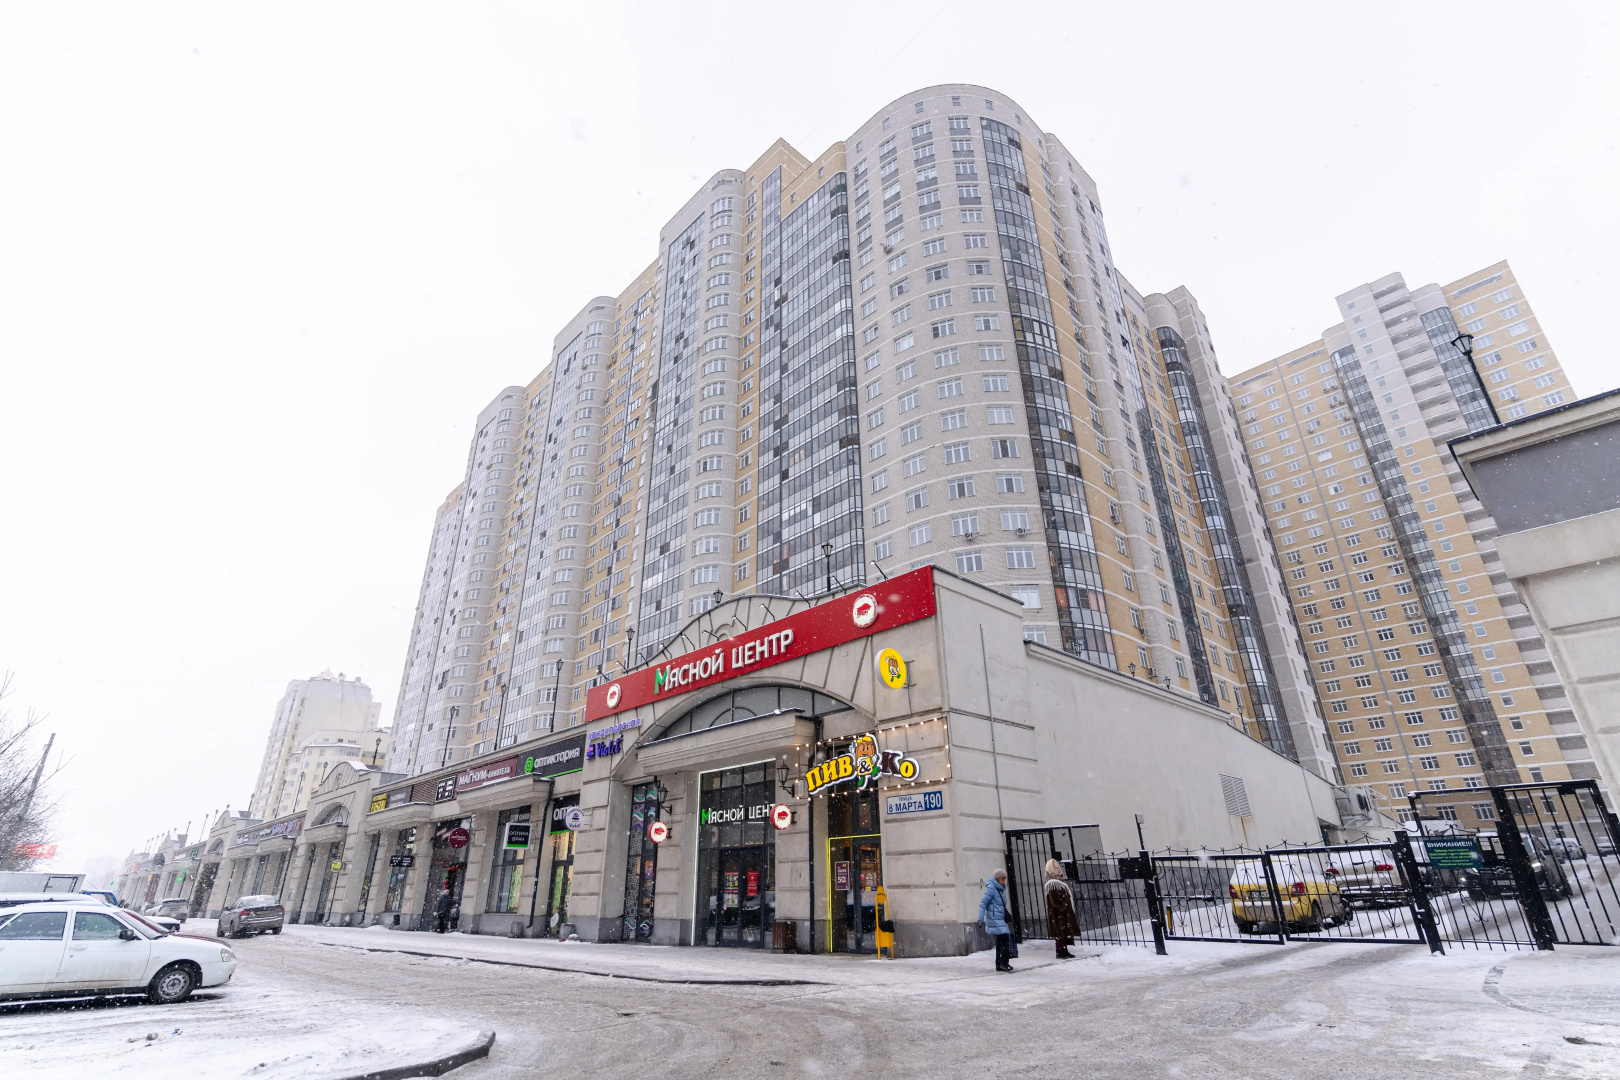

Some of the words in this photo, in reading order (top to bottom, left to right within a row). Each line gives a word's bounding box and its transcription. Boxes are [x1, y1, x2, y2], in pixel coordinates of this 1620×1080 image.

[732, 629, 794, 669] ЦЕНТР
[805, 755, 853, 792] ПИВ
[859, 760, 871, 774] &
[888, 804, 893, 813] 8
[895, 800, 923, 812] МАРТА
[924, 792, 942, 809] 190
